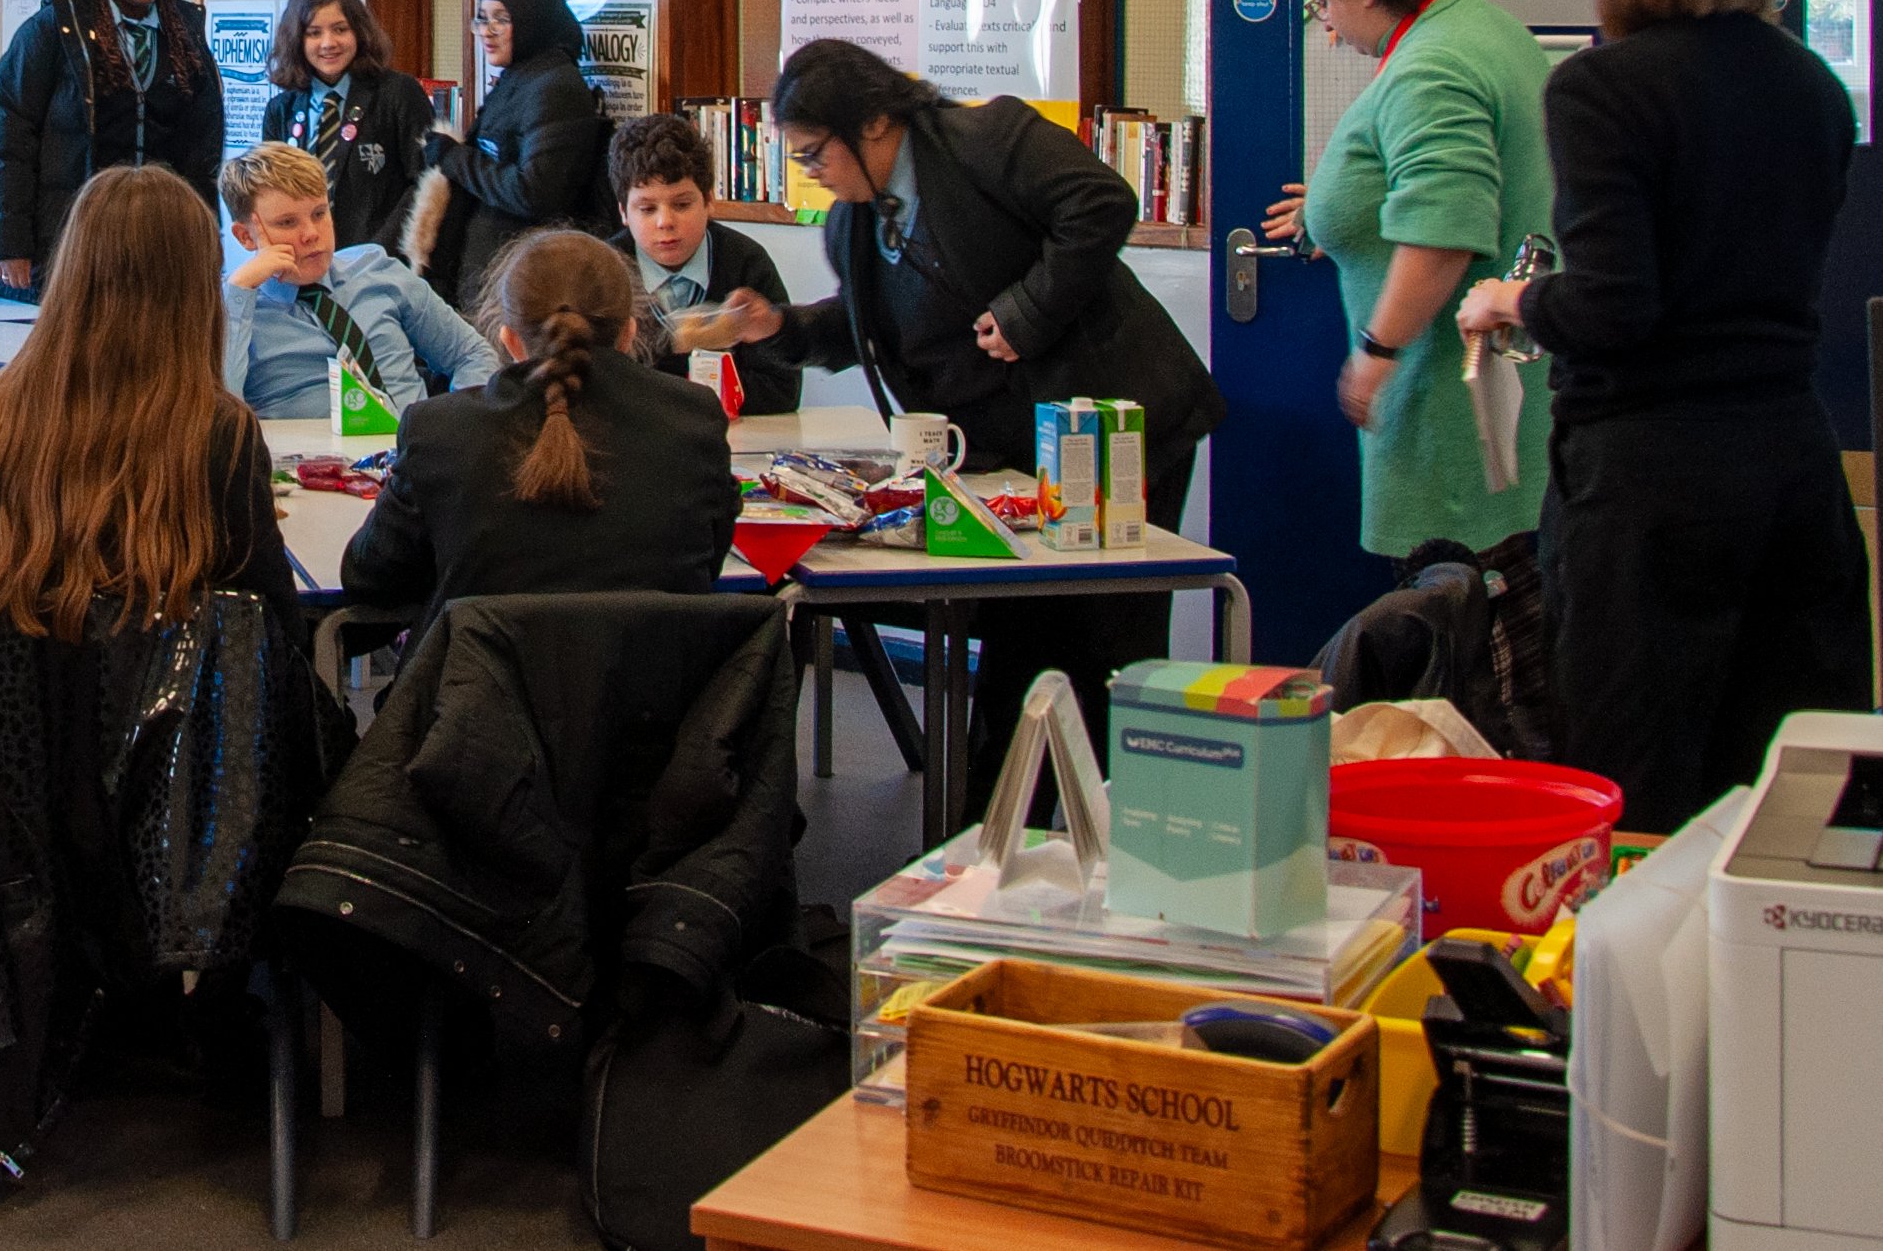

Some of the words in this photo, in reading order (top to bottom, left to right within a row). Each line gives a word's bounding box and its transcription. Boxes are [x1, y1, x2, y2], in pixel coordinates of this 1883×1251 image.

[791, 14, 807, 24] and
[810, 14, 867, 25] perspectives,
[870, 15, 880, 23] as
[883, 13, 901, 23] well
[904, 14, 914, 23] as
[936, 20, 967, 31] Evaluat
[982, 21, 1000, 32] exts
[1054, 21, 1066, 32] nd
[856, 34, 902, 46] conveyed,
[579, 34, 638, 62] ANALOGY
[929, 42, 963, 53] support
[967, 43, 984, 53] this
[987, 42, 1007, 53] with
[885, 57, 903, 65] exts.
[928, 63, 983, 76] appropriate
[986, 64, 1019, 75] textual
[938, 85, 981, 95] ferences.
[965, 1055, 1119, 1109] HOGWARTS
[1126, 1083, 1240, 1132] SCHOOL
[968, 1105, 1072, 1142] GRYFFINDOR
[1076, 1125, 1174, 1160] QUIDDITCH
[1180, 1143, 1228, 1170] TEAM
[995, 1144, 1105, 1183] BROOMSTICK
[1109, 1166, 1169, 1196] REPAIR
[1175, 1179, 1205, 1201] KIT
